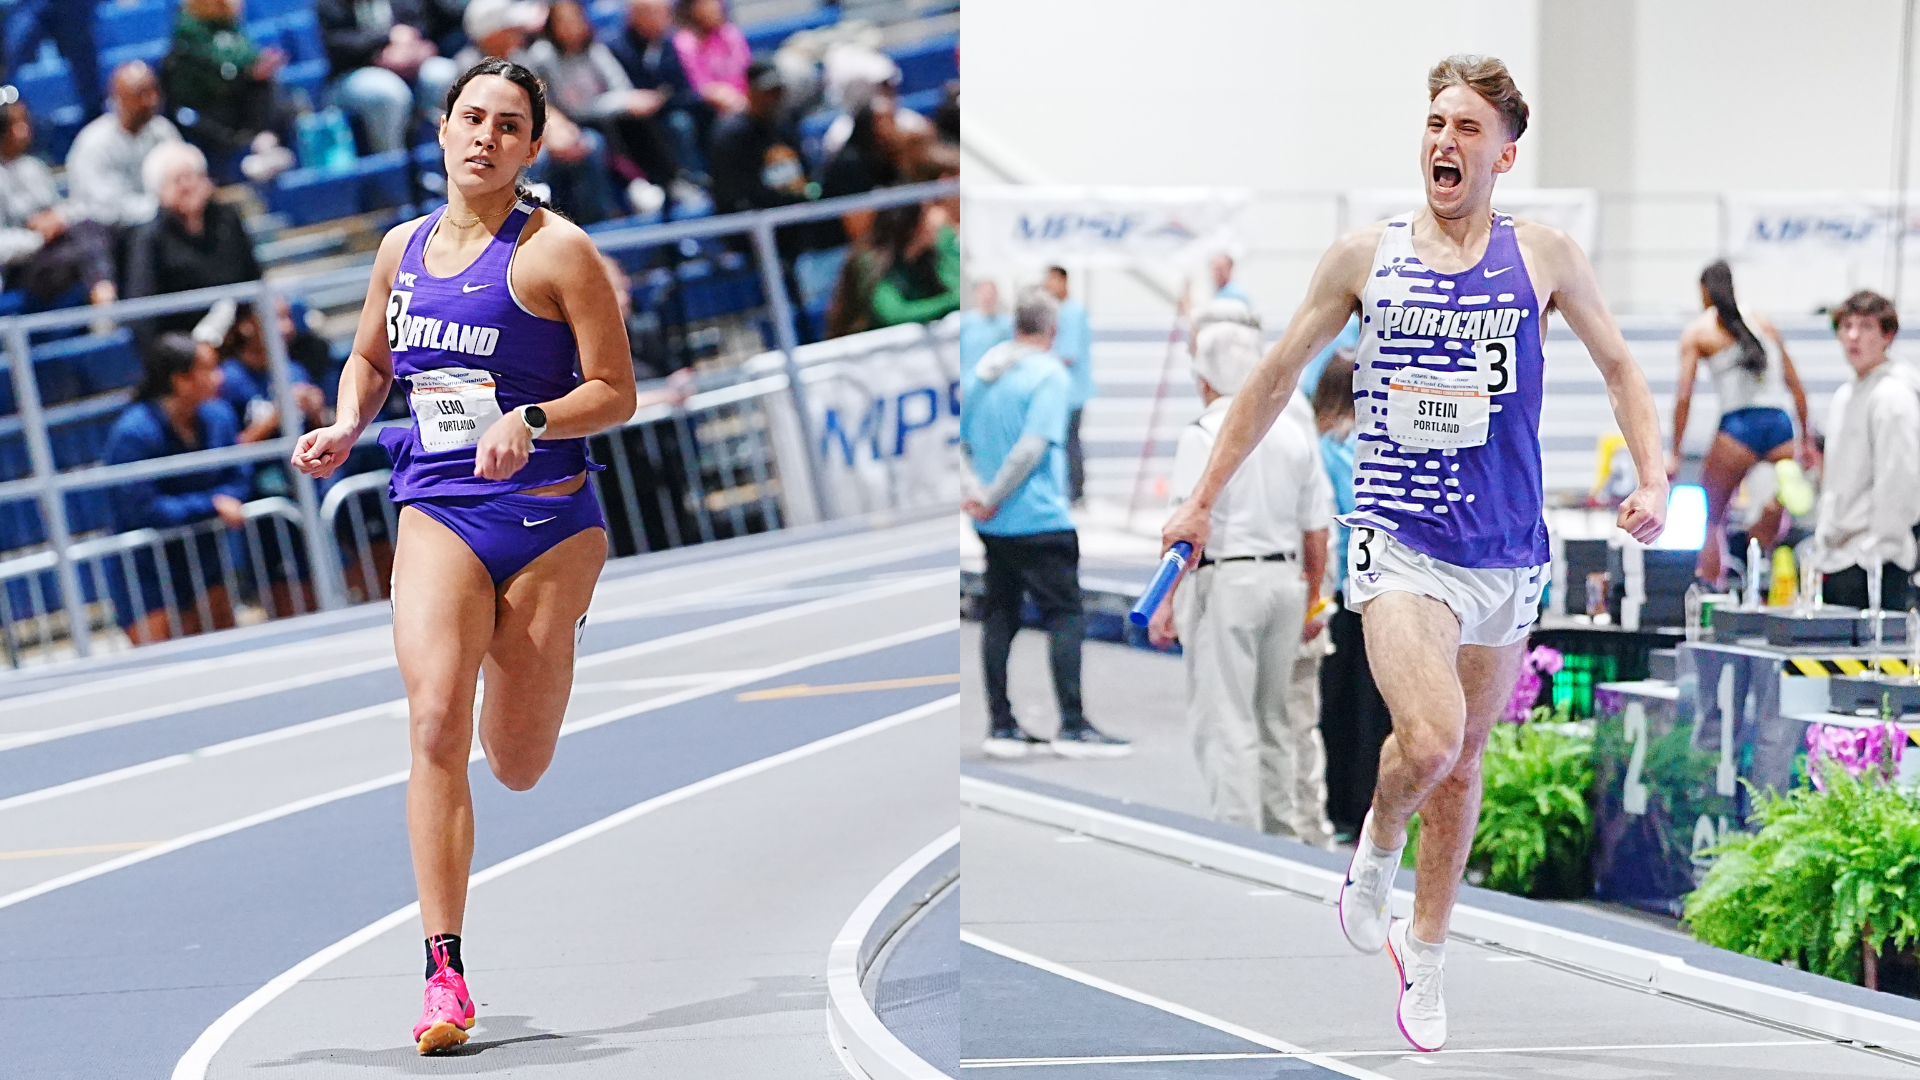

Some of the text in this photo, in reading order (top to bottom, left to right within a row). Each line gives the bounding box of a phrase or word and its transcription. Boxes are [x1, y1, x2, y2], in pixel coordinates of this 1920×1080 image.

[389, 294, 403, 349] 3
[402, 314, 500, 357] ORTLAND
[1383, 305, 1521, 340] PORTLAND
[1485, 342, 1509, 393] 3
[438, 419, 476, 432] PORTLAND
[1413, 420, 1460, 434] PORTLAND
[1418, 400, 1457, 418] STEIN
[1356, 527, 1375, 571] 3
[1717, 663, 1736, 797] 1
[1623, 701, 1647, 815] 2
